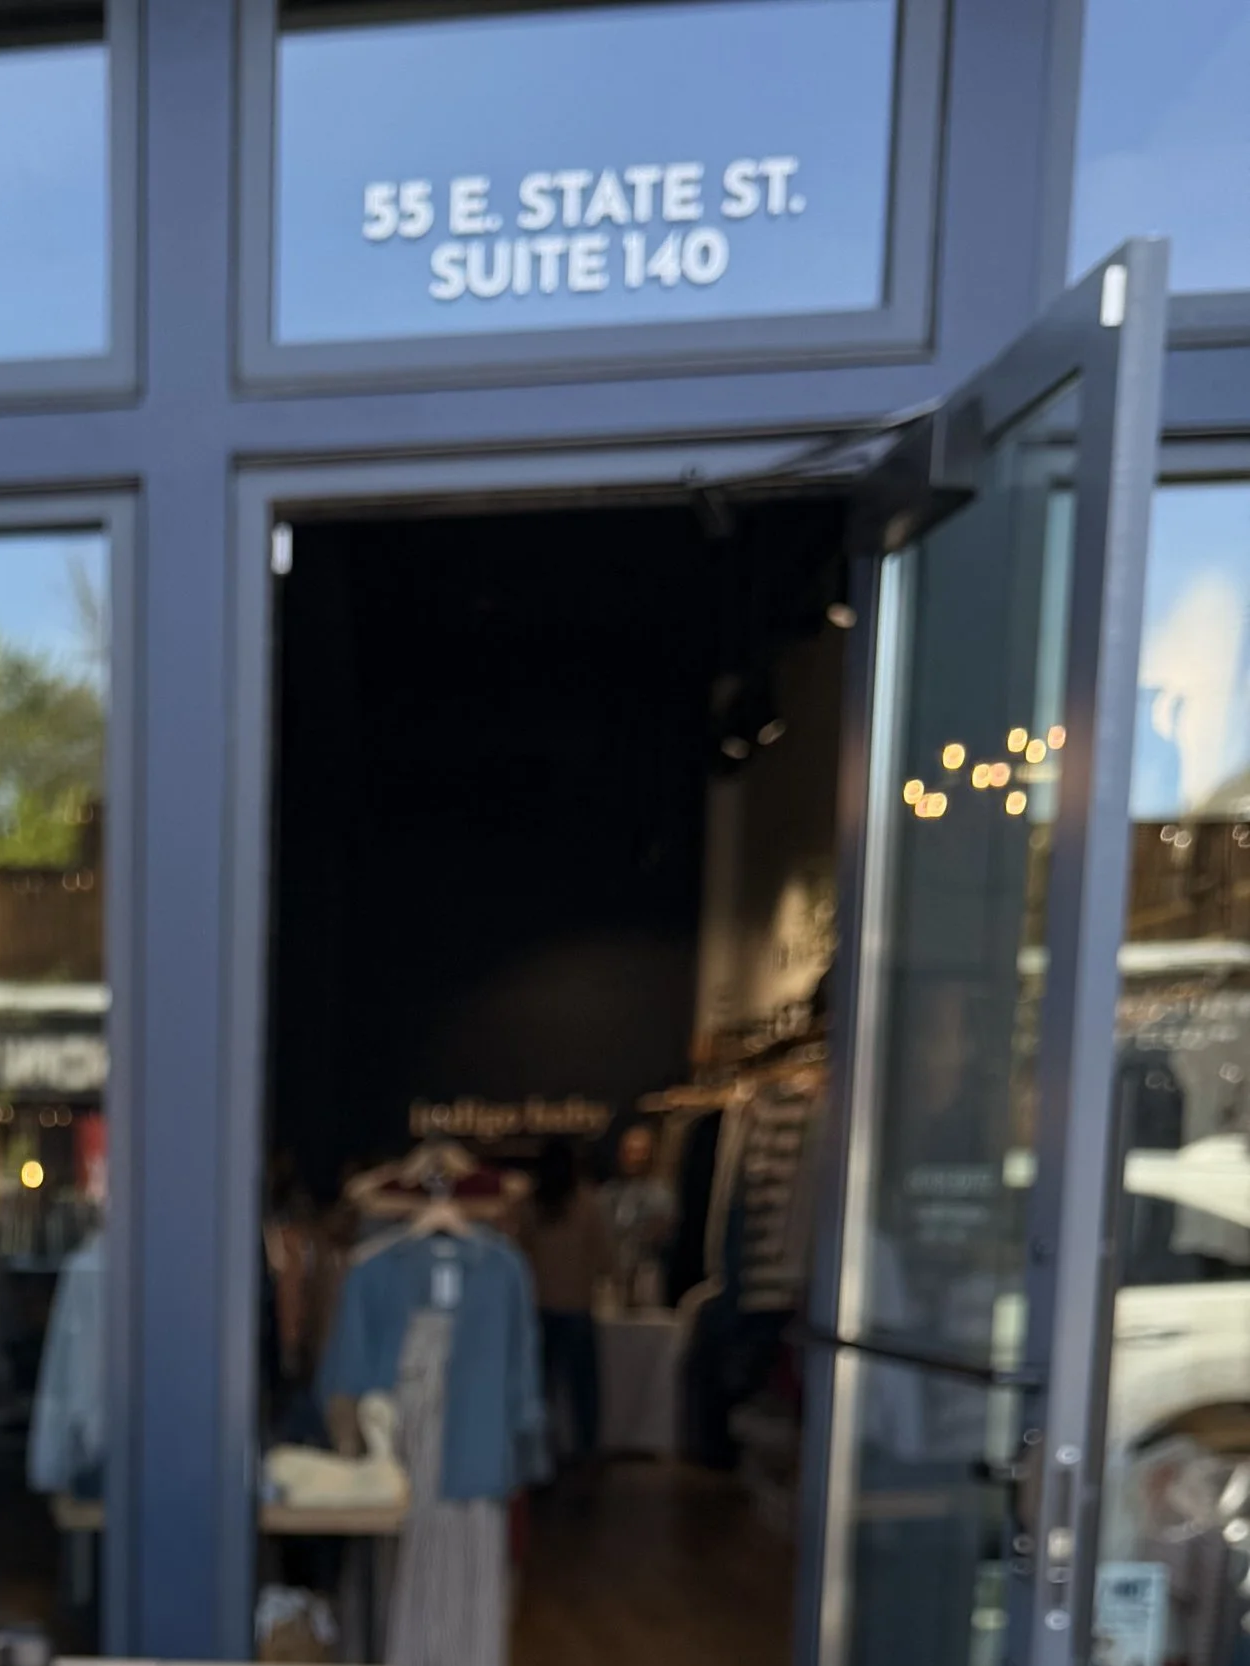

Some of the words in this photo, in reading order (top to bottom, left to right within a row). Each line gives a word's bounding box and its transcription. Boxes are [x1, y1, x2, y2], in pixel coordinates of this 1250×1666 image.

[362, 178, 435, 240] 55
[449, 174, 503, 234] E.
[516, 160, 705, 231] STATE
[721, 154, 807, 219] ST.
[429, 230, 611, 300] SUITE
[623, 226, 730, 289] 140
